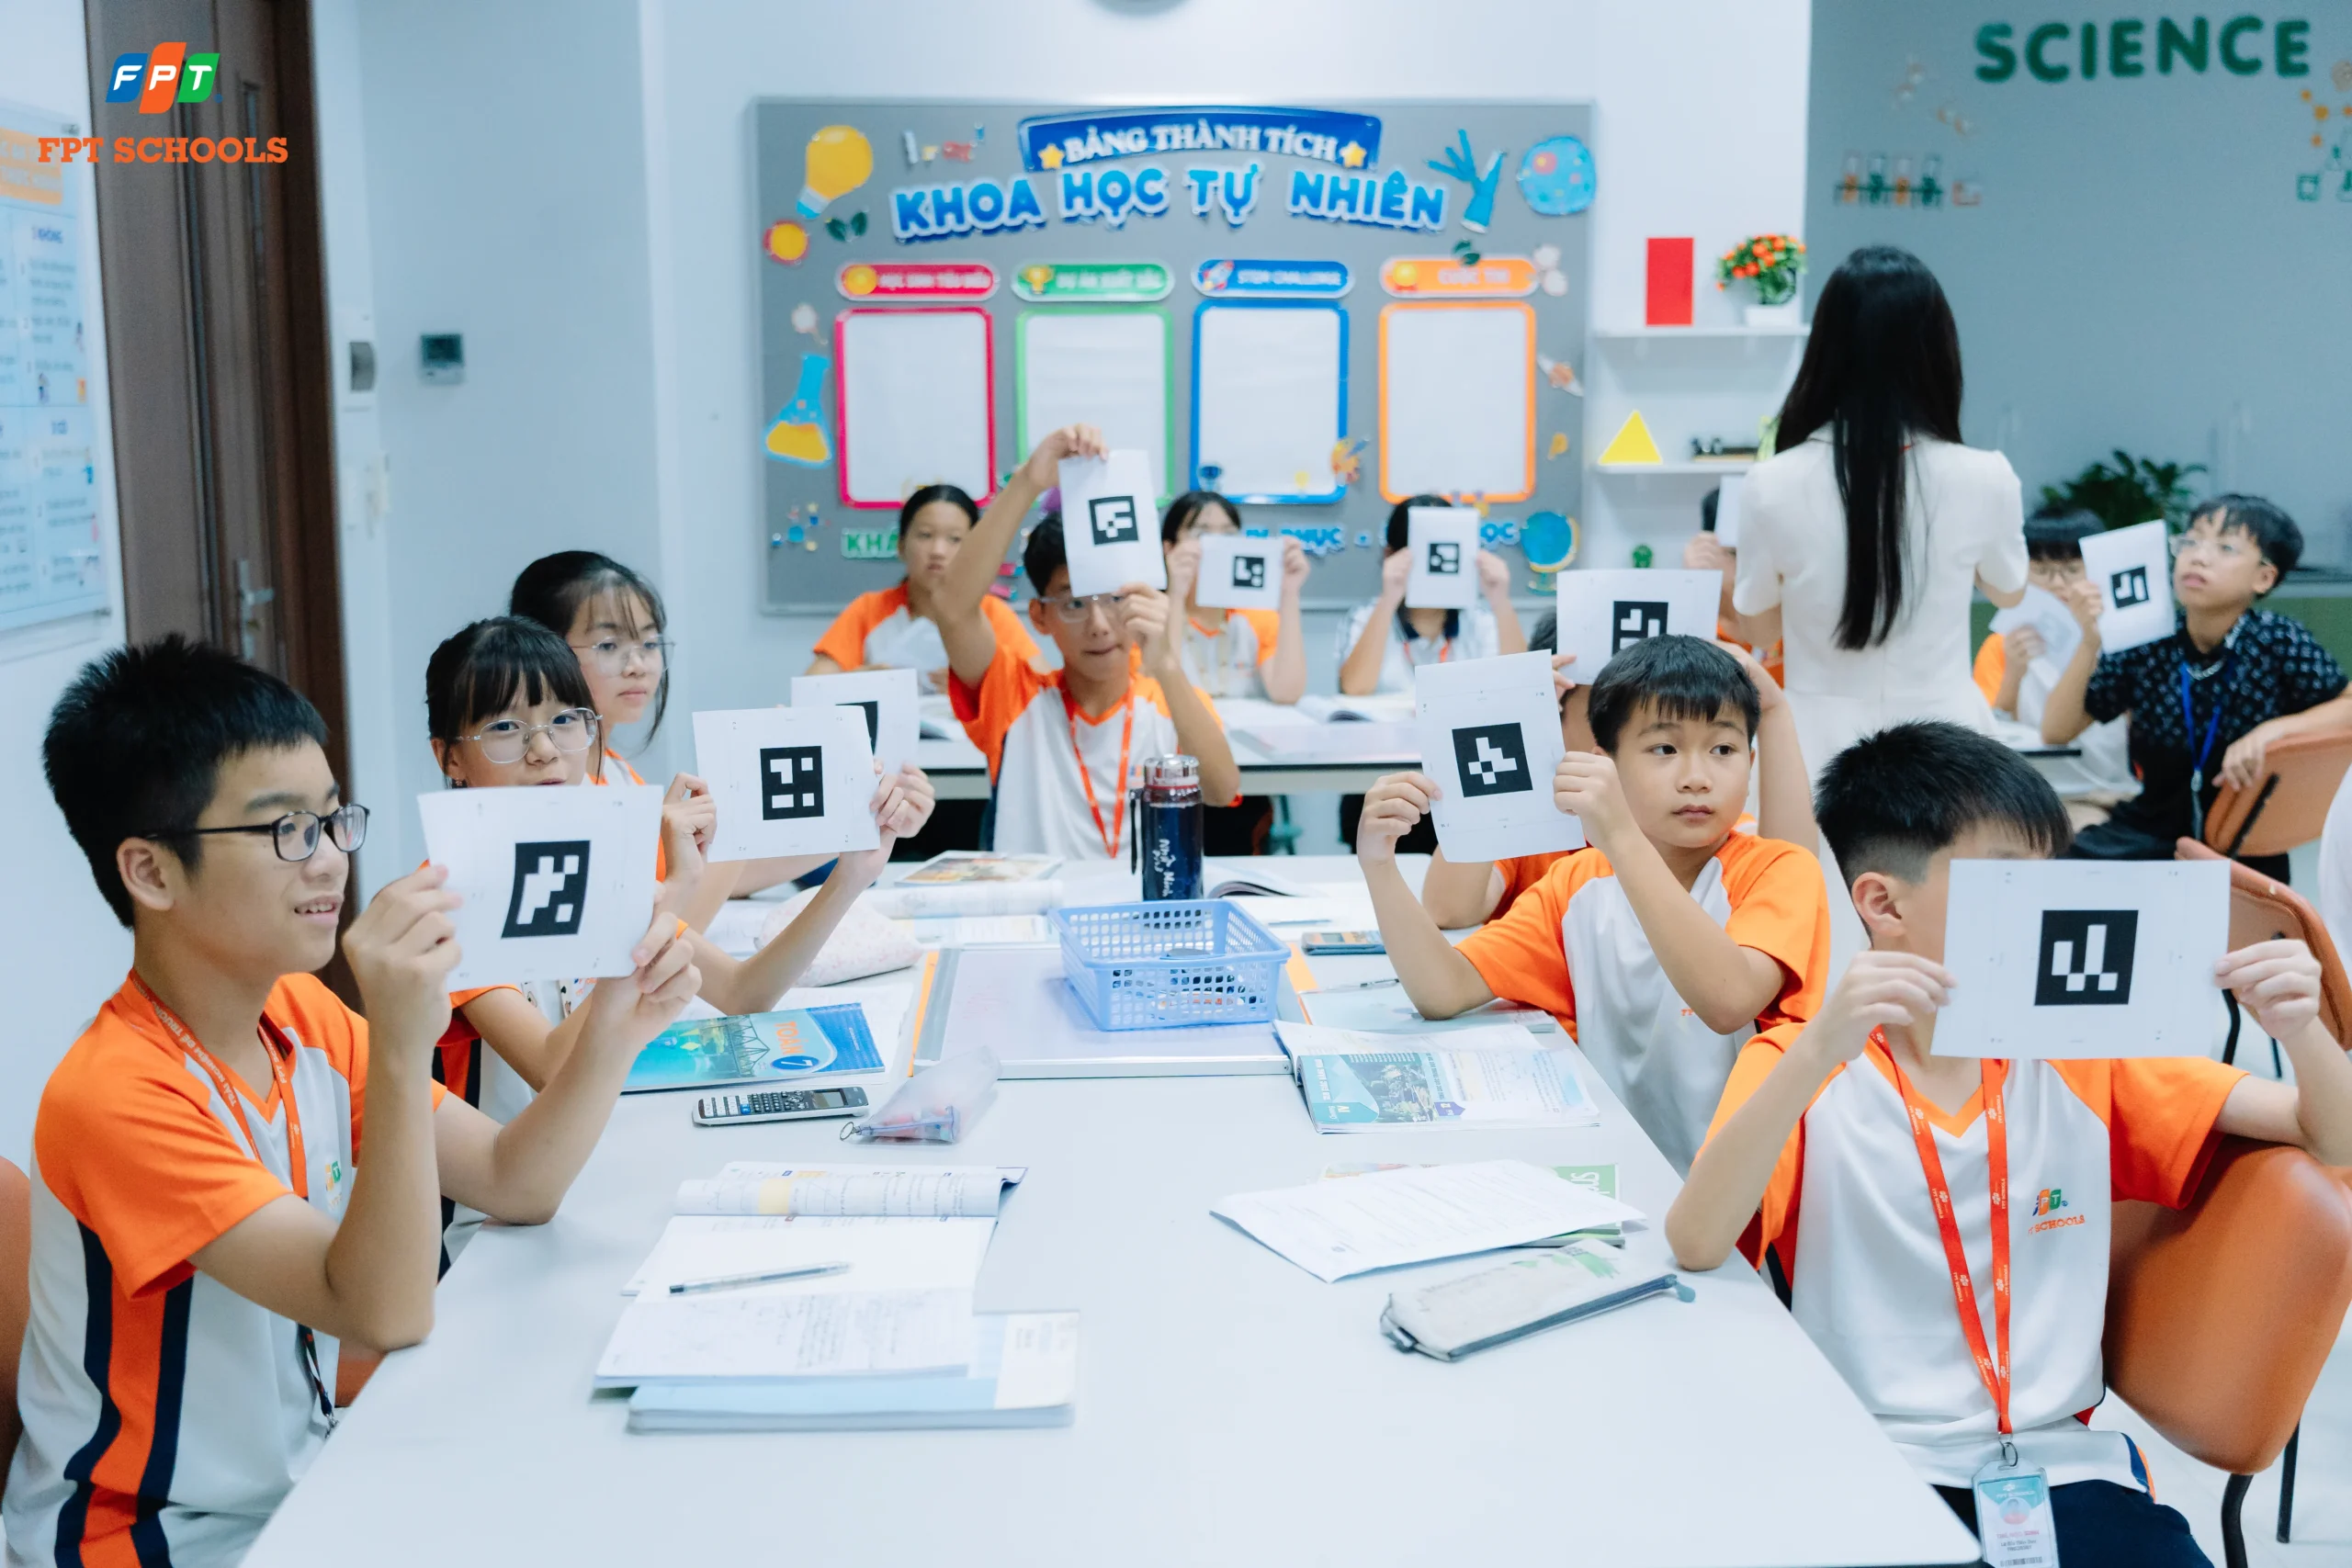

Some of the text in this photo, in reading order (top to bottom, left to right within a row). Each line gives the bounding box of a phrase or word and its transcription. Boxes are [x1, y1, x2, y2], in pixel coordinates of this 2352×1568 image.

[1974, 15, 2311, 84] SCIENCE
[1064, 118, 1339, 164] BẢNG THÀNH TÍCH
[894, 163, 1444, 232] KHOA HỌC TỰ NHIÊN
[774, 1021, 808, 1055] TOÁN
[2035, 1214, 2086, 1234] SCHOOLS
